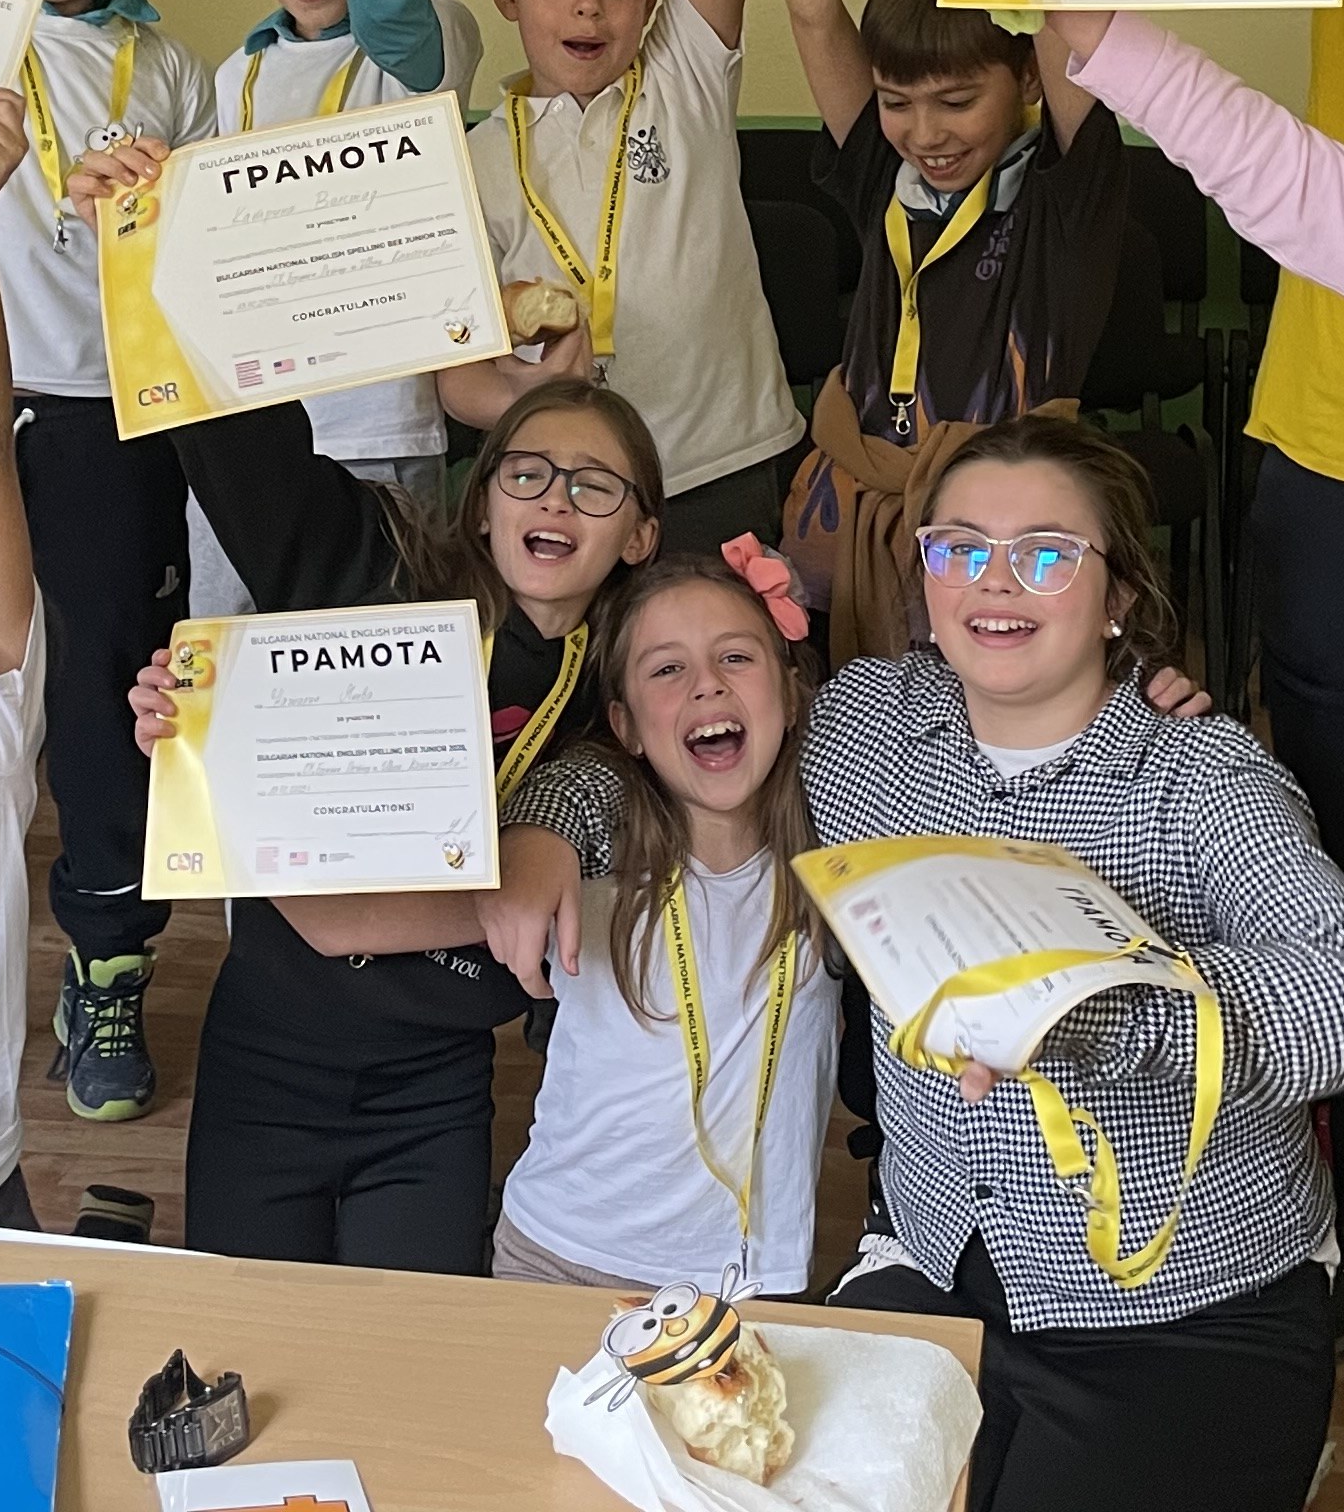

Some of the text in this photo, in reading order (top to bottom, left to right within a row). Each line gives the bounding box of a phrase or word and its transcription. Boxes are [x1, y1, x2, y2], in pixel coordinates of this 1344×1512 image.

[198, 116, 433, 170] BULGARIAN NATIONAL ENGLISH SPELLING BEE
[222, 133, 421, 194] ГРАМОТА
[250, 623, 455, 645] BULGARIAN NATIONAL ENGLISH SPELLING BEE
[270, 639, 442, 673] ГРАМОТА
[523, 705, 555, 751] NATIONAL
[1057, 887, 1154, 966] ГРАМОА
[450, 956, 481, 980] YOU.
[676, 943, 692, 1000] NATIONAL
[686, 1002, 701, 1051] ENGLISH
[768, 951, 788, 1056] NATIONAL ENGLISH
